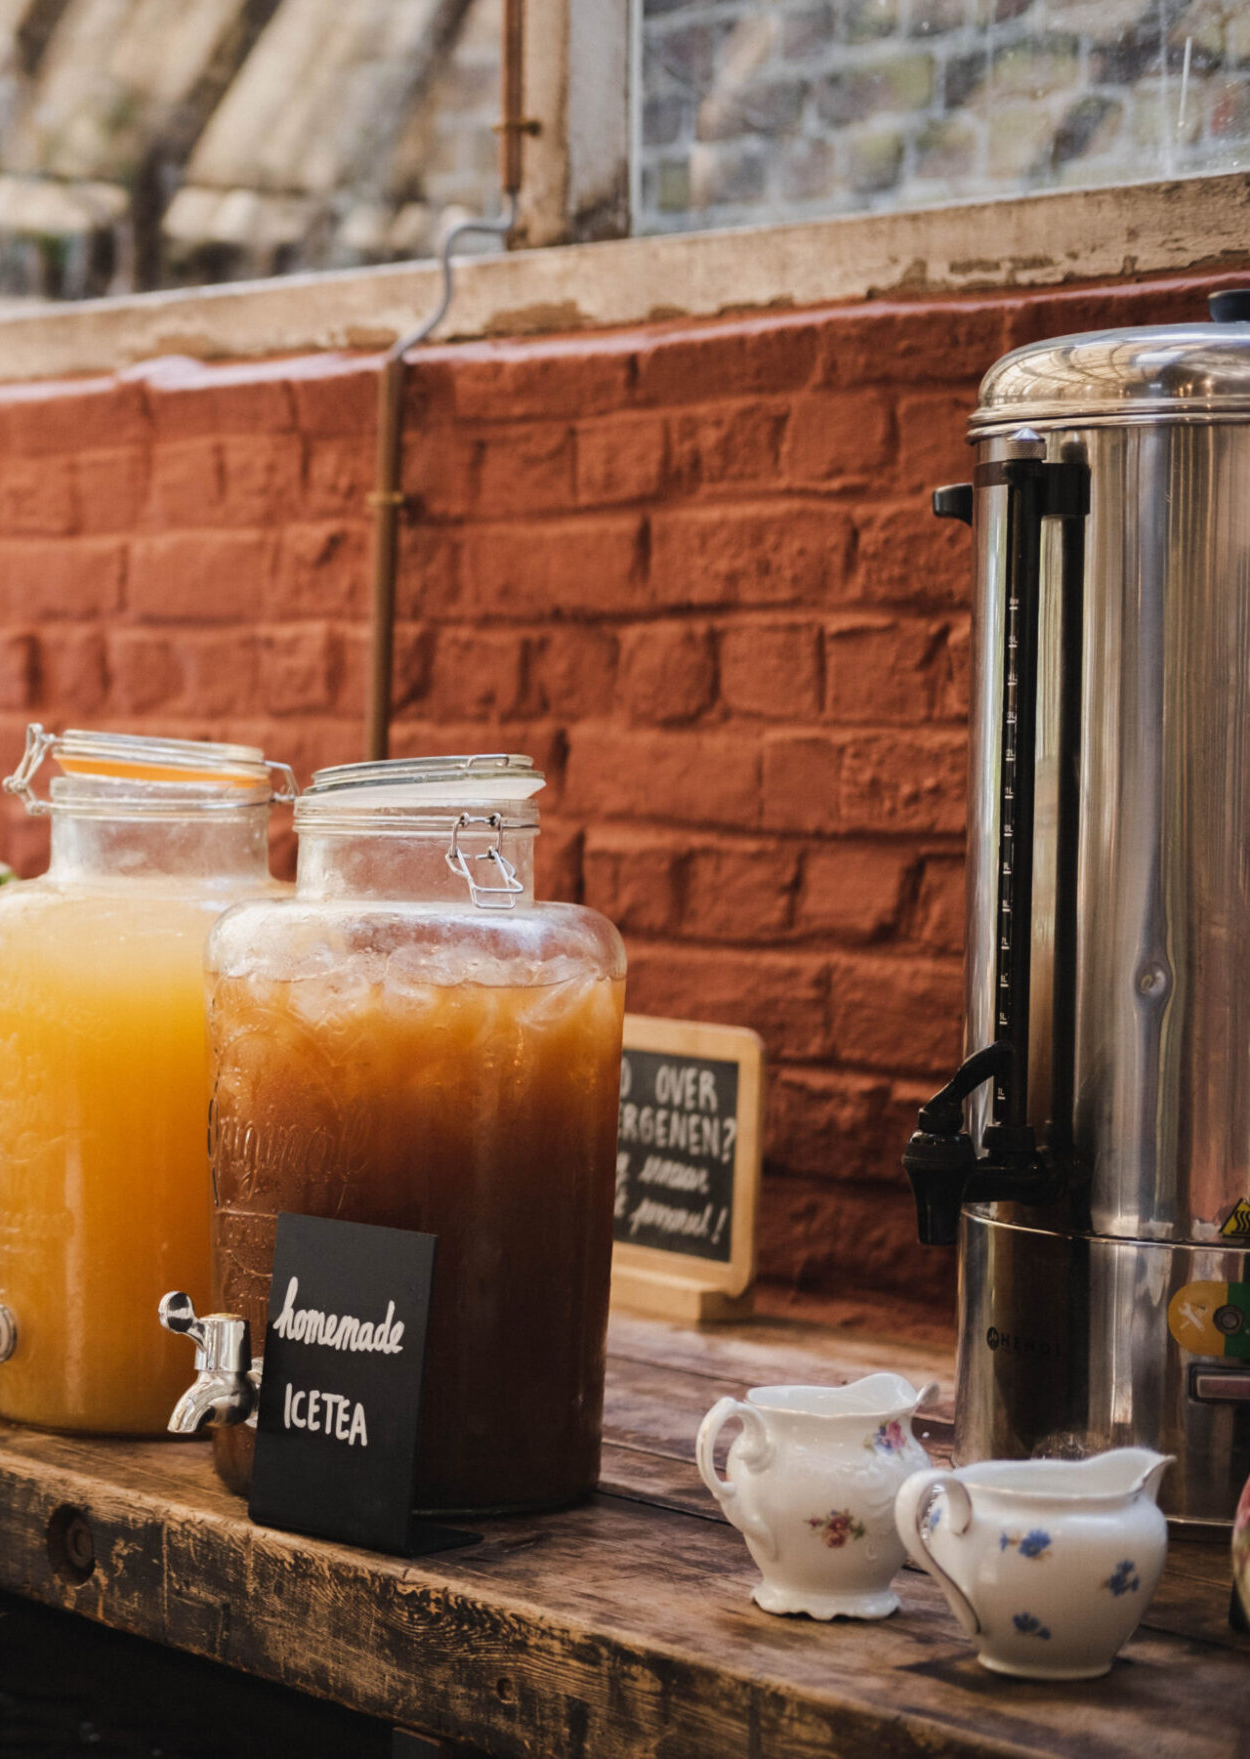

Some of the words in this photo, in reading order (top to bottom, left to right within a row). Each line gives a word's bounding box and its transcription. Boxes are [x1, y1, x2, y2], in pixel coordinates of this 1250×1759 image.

[654, 1064, 718, 1112] OVER
[272, 1276, 405, 1354] homemade
[283, 1382, 368, 1447] ICETEA
